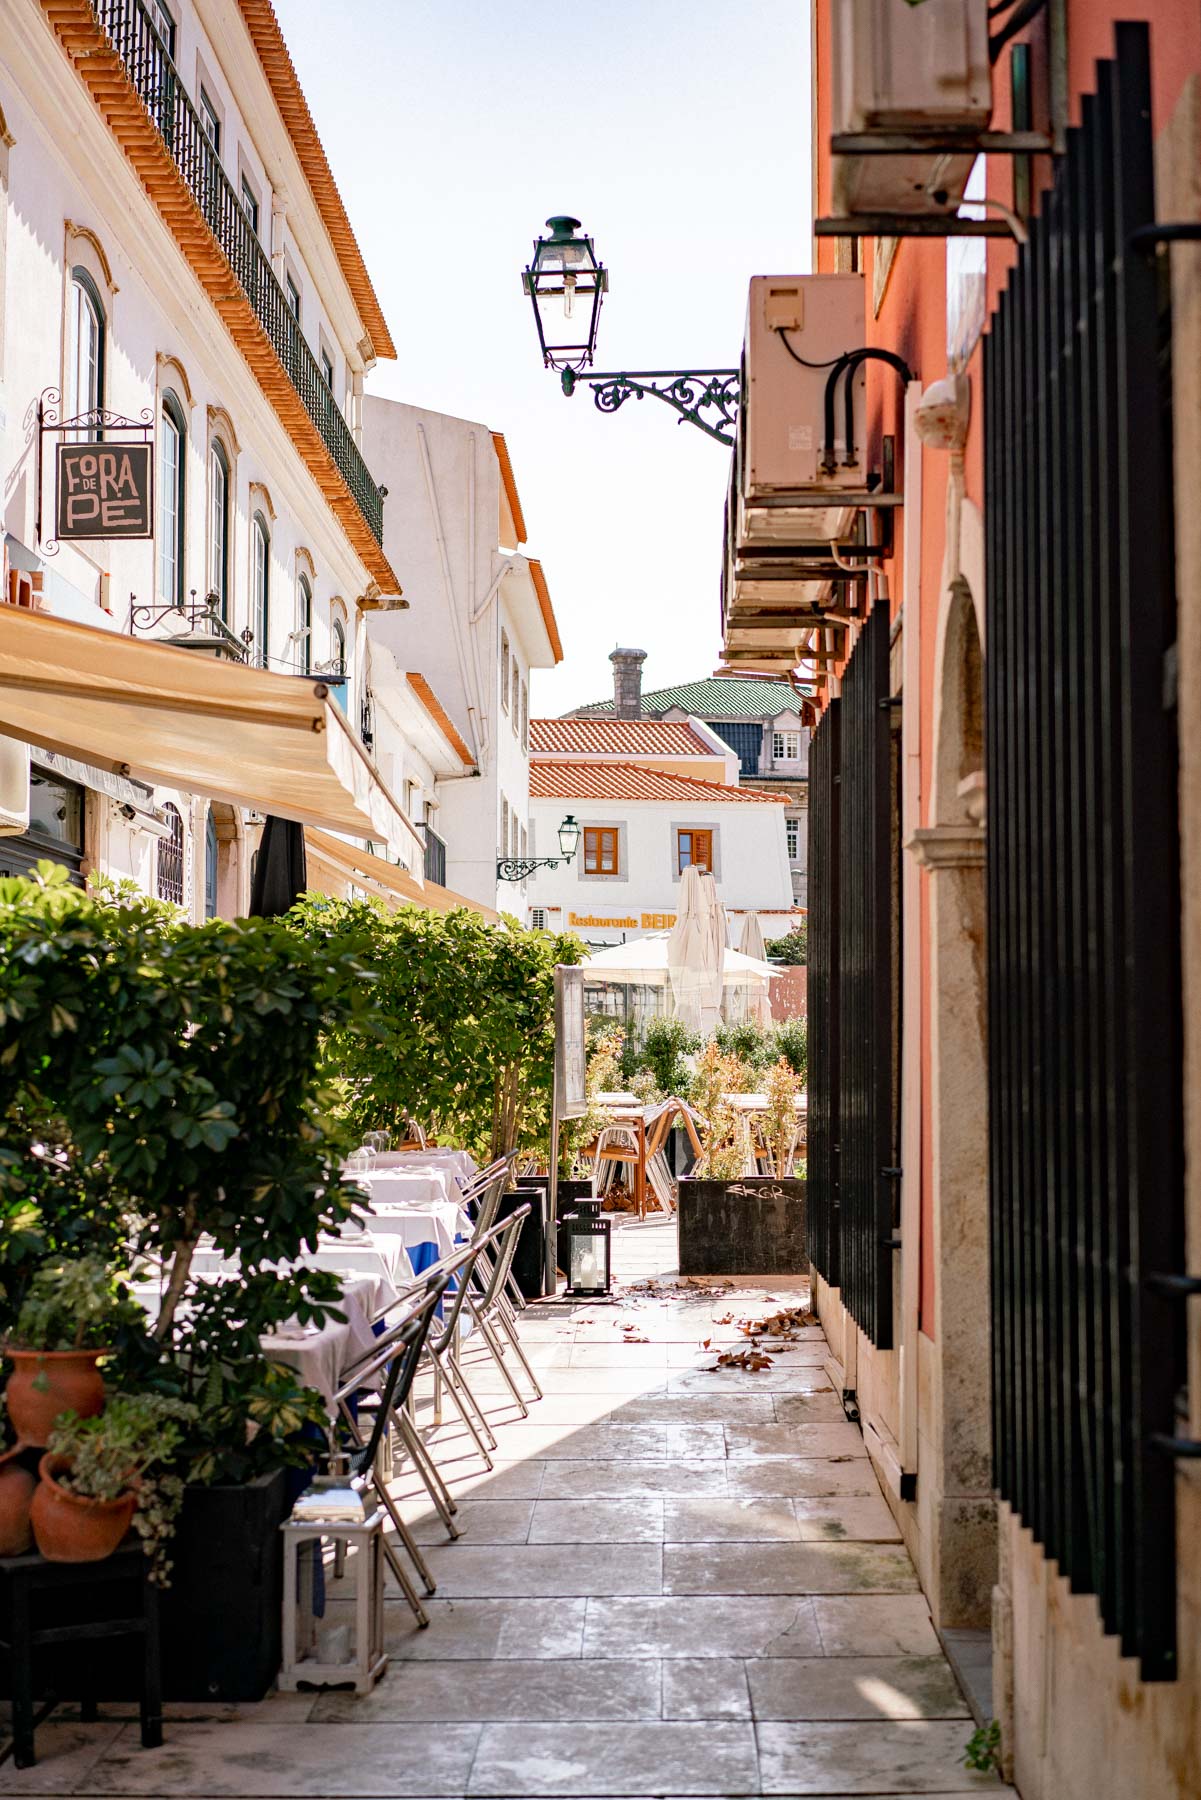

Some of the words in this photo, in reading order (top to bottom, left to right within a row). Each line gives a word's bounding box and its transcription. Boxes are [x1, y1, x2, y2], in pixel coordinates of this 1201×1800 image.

[65, 453, 139, 499] FORA
[82, 478, 97, 490] DE
[67, 493, 142, 529] PE
[568, 911, 639, 929] Restaurante
[641, 913, 677, 929] BEIR
